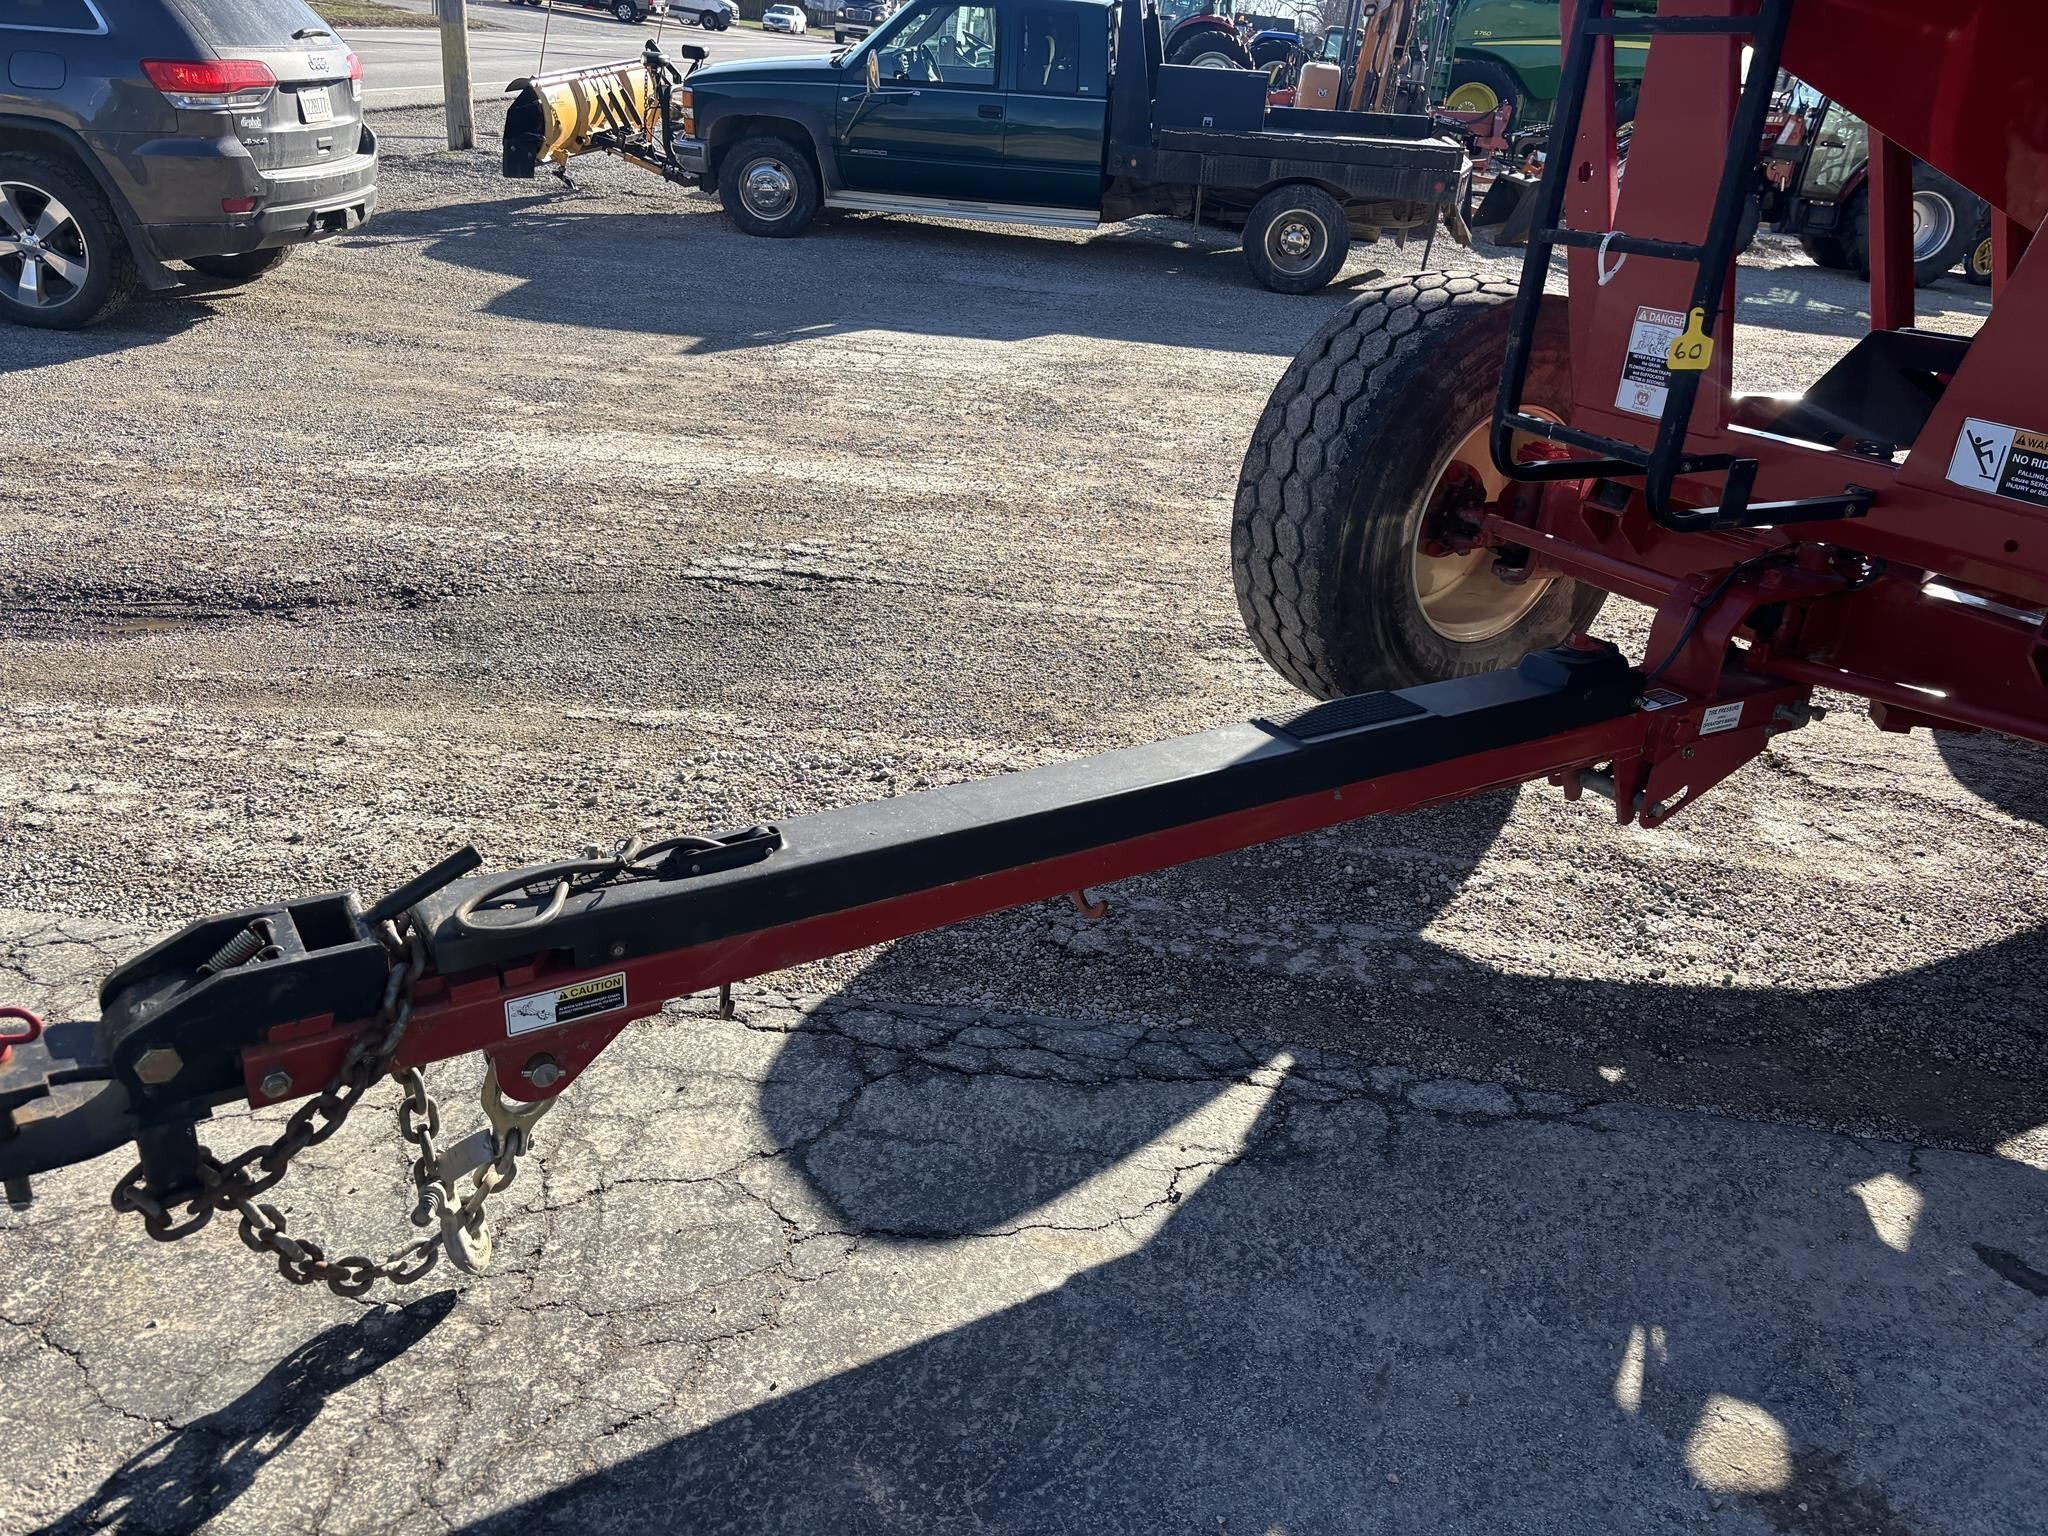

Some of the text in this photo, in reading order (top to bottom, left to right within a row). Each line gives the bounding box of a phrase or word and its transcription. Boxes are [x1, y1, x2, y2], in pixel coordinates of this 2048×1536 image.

[1674, 343, 1702, 360] 60
[2012, 453, 2029, 465] NO
[2010, 476, 2029, 484] cause
[2017, 469, 2045, 480] FALLING
[2005, 481, 2029, 492] INJURY
[570, 977, 621, 997] CAUTION
